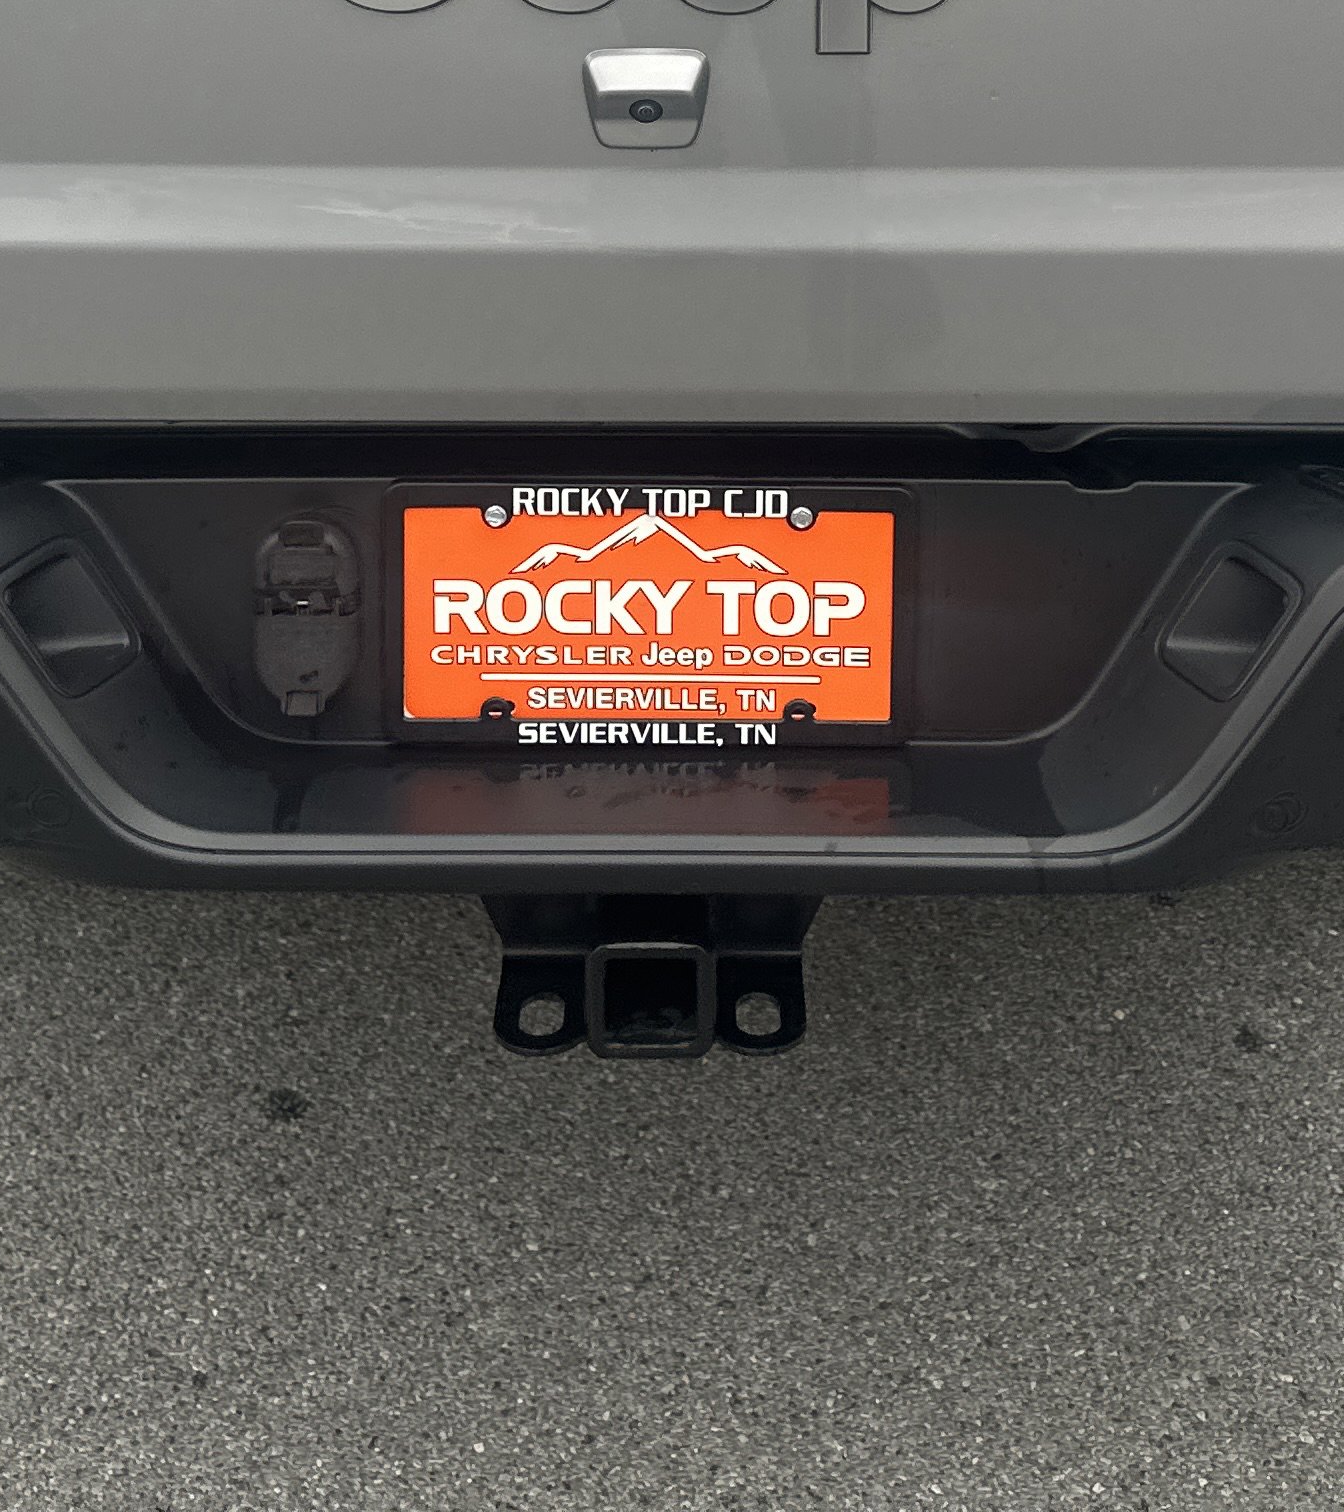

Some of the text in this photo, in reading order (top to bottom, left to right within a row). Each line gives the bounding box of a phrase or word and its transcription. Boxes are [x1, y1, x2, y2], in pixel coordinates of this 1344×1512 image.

[512, 487, 789, 519] ROCKY TOP CJD
[433, 579, 867, 637] ROCKY TOP
[430, 641, 871, 670] CHRYSLER Jeep DODGE
[526, 686, 777, 716] SEVIERVILLE, TN
[518, 722, 777, 747] SEVIERVILLE, TN
